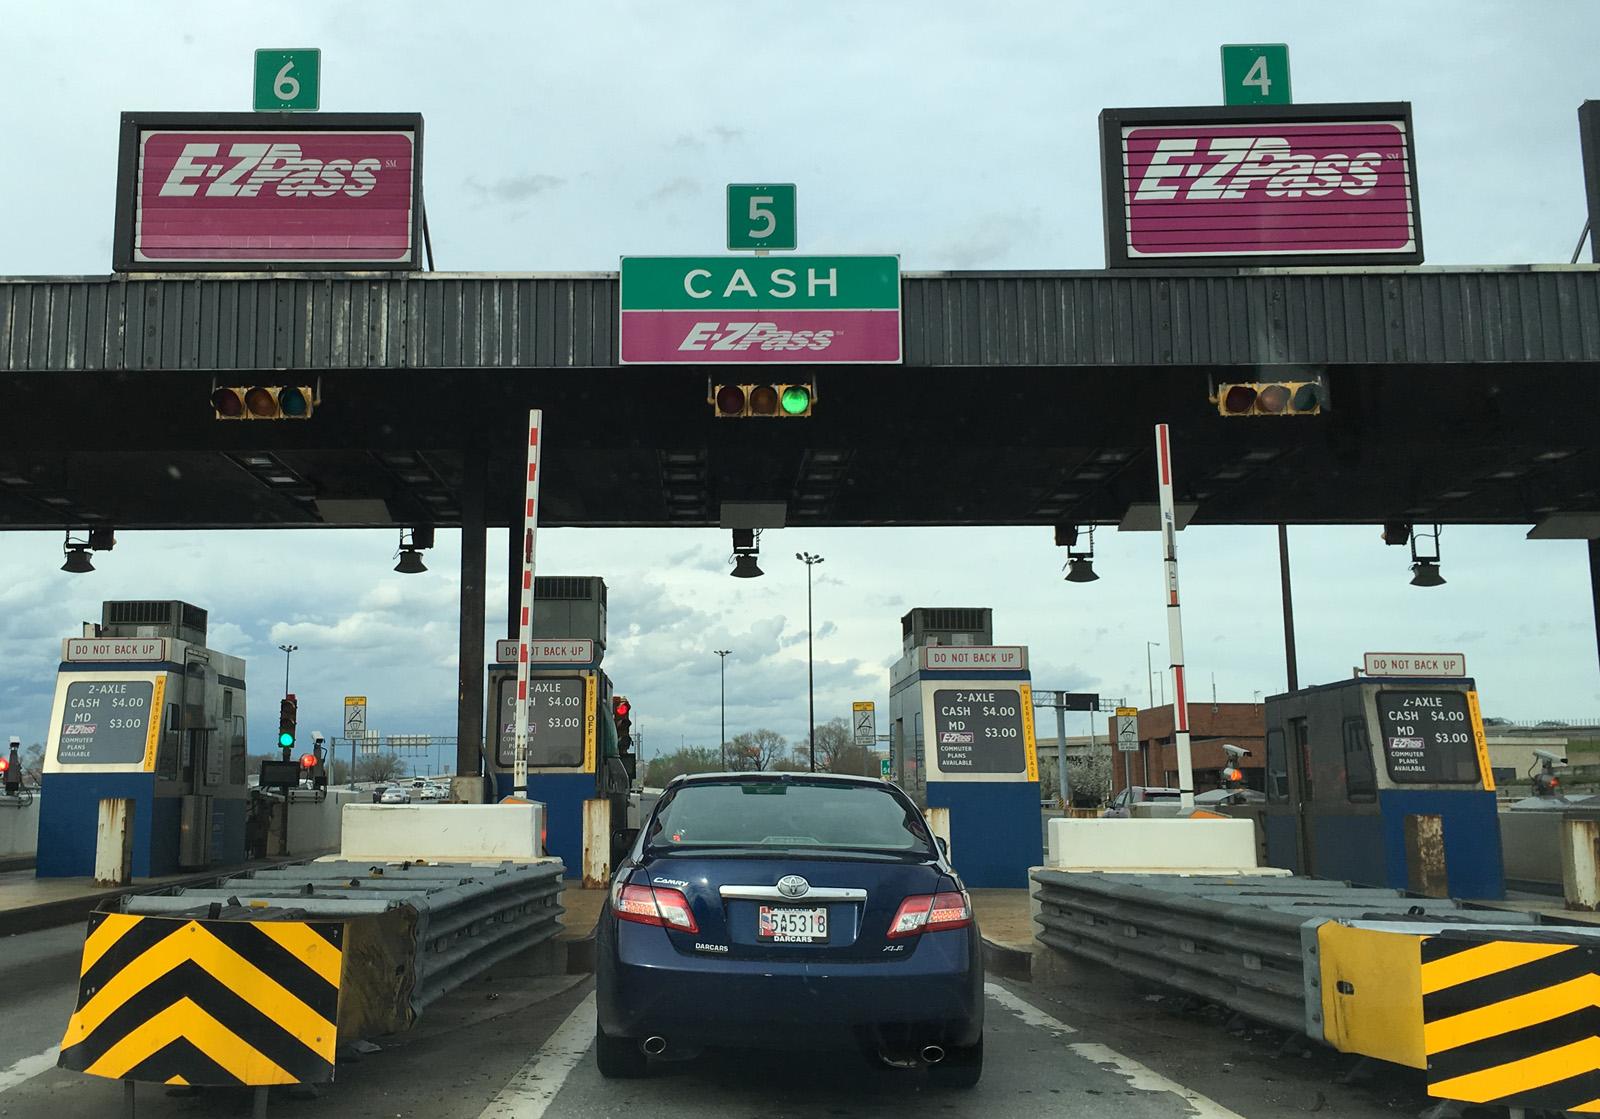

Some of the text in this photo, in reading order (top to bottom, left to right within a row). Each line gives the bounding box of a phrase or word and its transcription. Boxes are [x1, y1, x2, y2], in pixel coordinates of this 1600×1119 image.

[273, 60, 300, 101] 6
[1242, 56, 1272, 96] 4
[748, 196, 776, 238] 5
[683, 267, 838, 299] CASH
[76, 644, 154, 655] DO NOT BACK UP
[505, 647, 517, 656] DO
[544, 647, 567, 656] BACK
[571, 647, 584, 656] UP
[934, 653, 1014, 663] DO NOT BACK UP
[1374, 660, 1456, 670] DO NOT BACK UP
[88, 684, 127, 694] 2-AXLE
[530, 683, 561, 693] -AXLE
[71, 697, 144, 708] CASH $4.00
[507, 696, 580, 706] CH $4.00
[956, 693, 995, 703] 2-AXLE
[1403, 697, 1443, 707] 2-AXLE
[941, 706, 1015, 717] CASH $4.00
[1388, 711, 1464, 722] CASH $4.00
[75, 713, 91, 722] MD
[548, 717, 580, 728] $3.00
[109, 718, 141, 729] $3.00
[948, 721, 966, 731] MD
[984, 727, 1017, 738] $3.00
[1397, 726, 1415, 736] MD
[1435, 733, 1468, 744] $3.00
[695, 942, 729, 952] DARCARS
